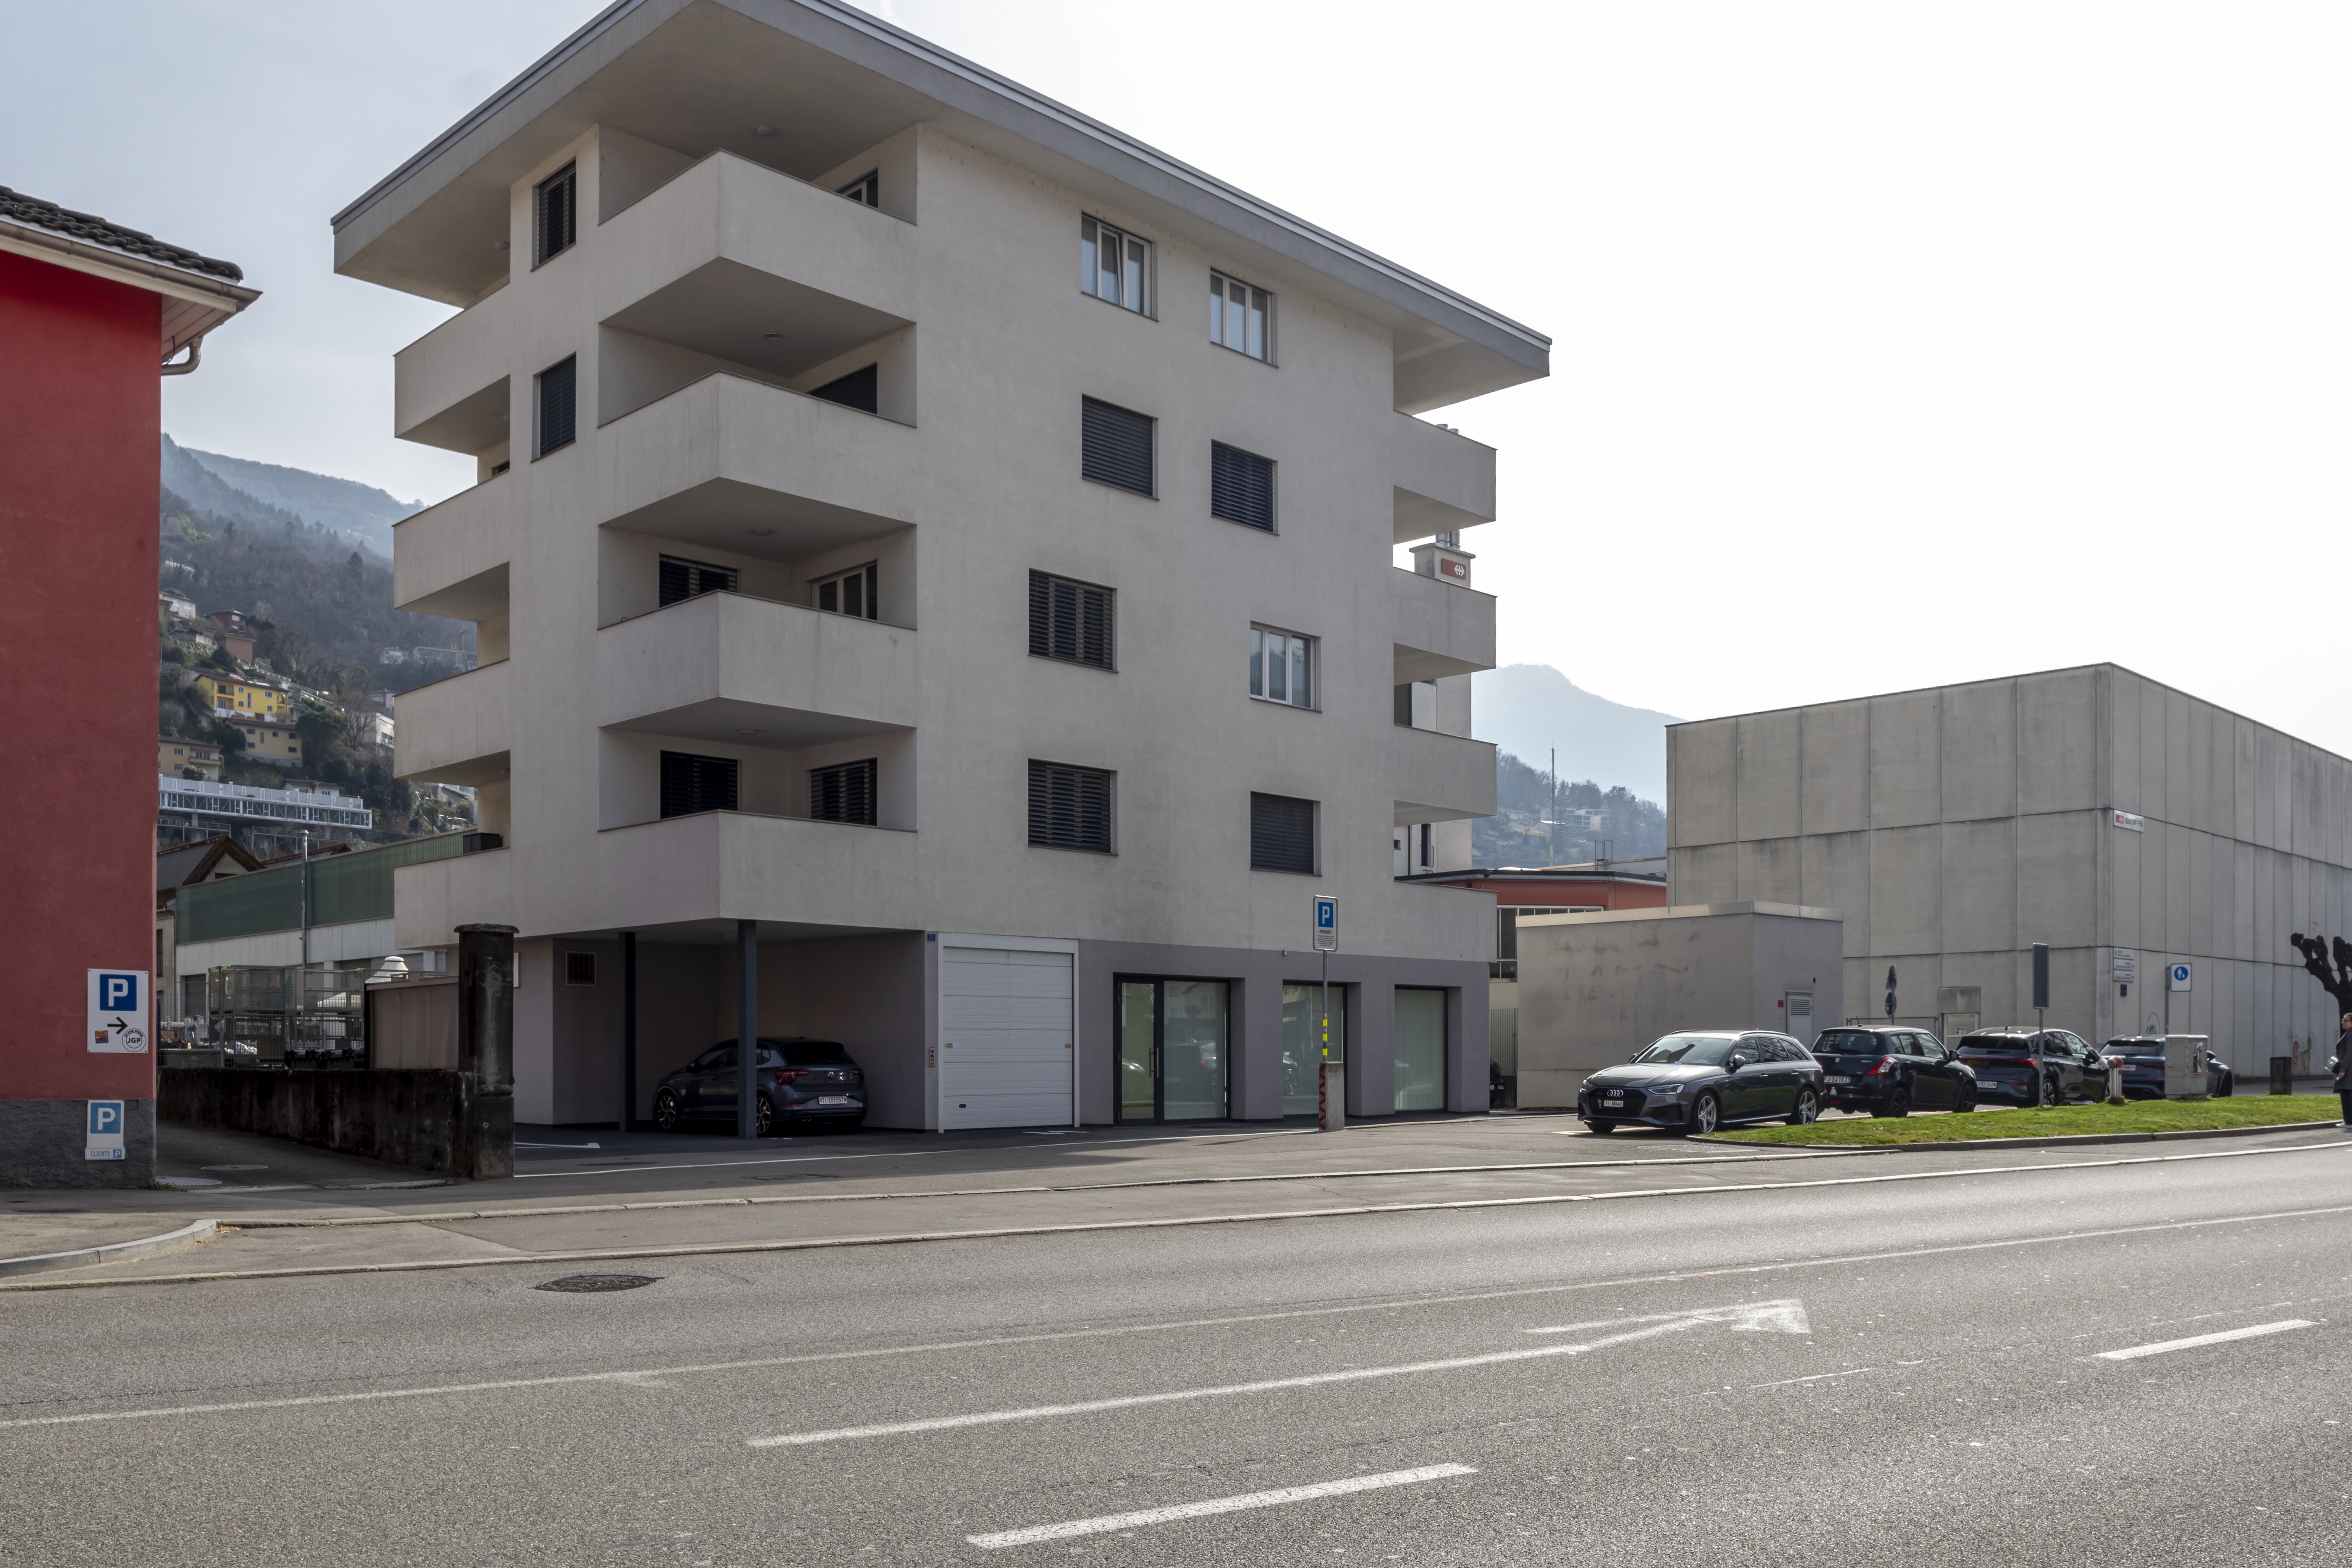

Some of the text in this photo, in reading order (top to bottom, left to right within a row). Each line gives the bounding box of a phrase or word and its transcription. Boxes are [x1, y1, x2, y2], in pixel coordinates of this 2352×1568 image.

[1322, 906, 1330, 925] P
[108, 978, 129, 1007] P
[97, 1107, 116, 1131] P
